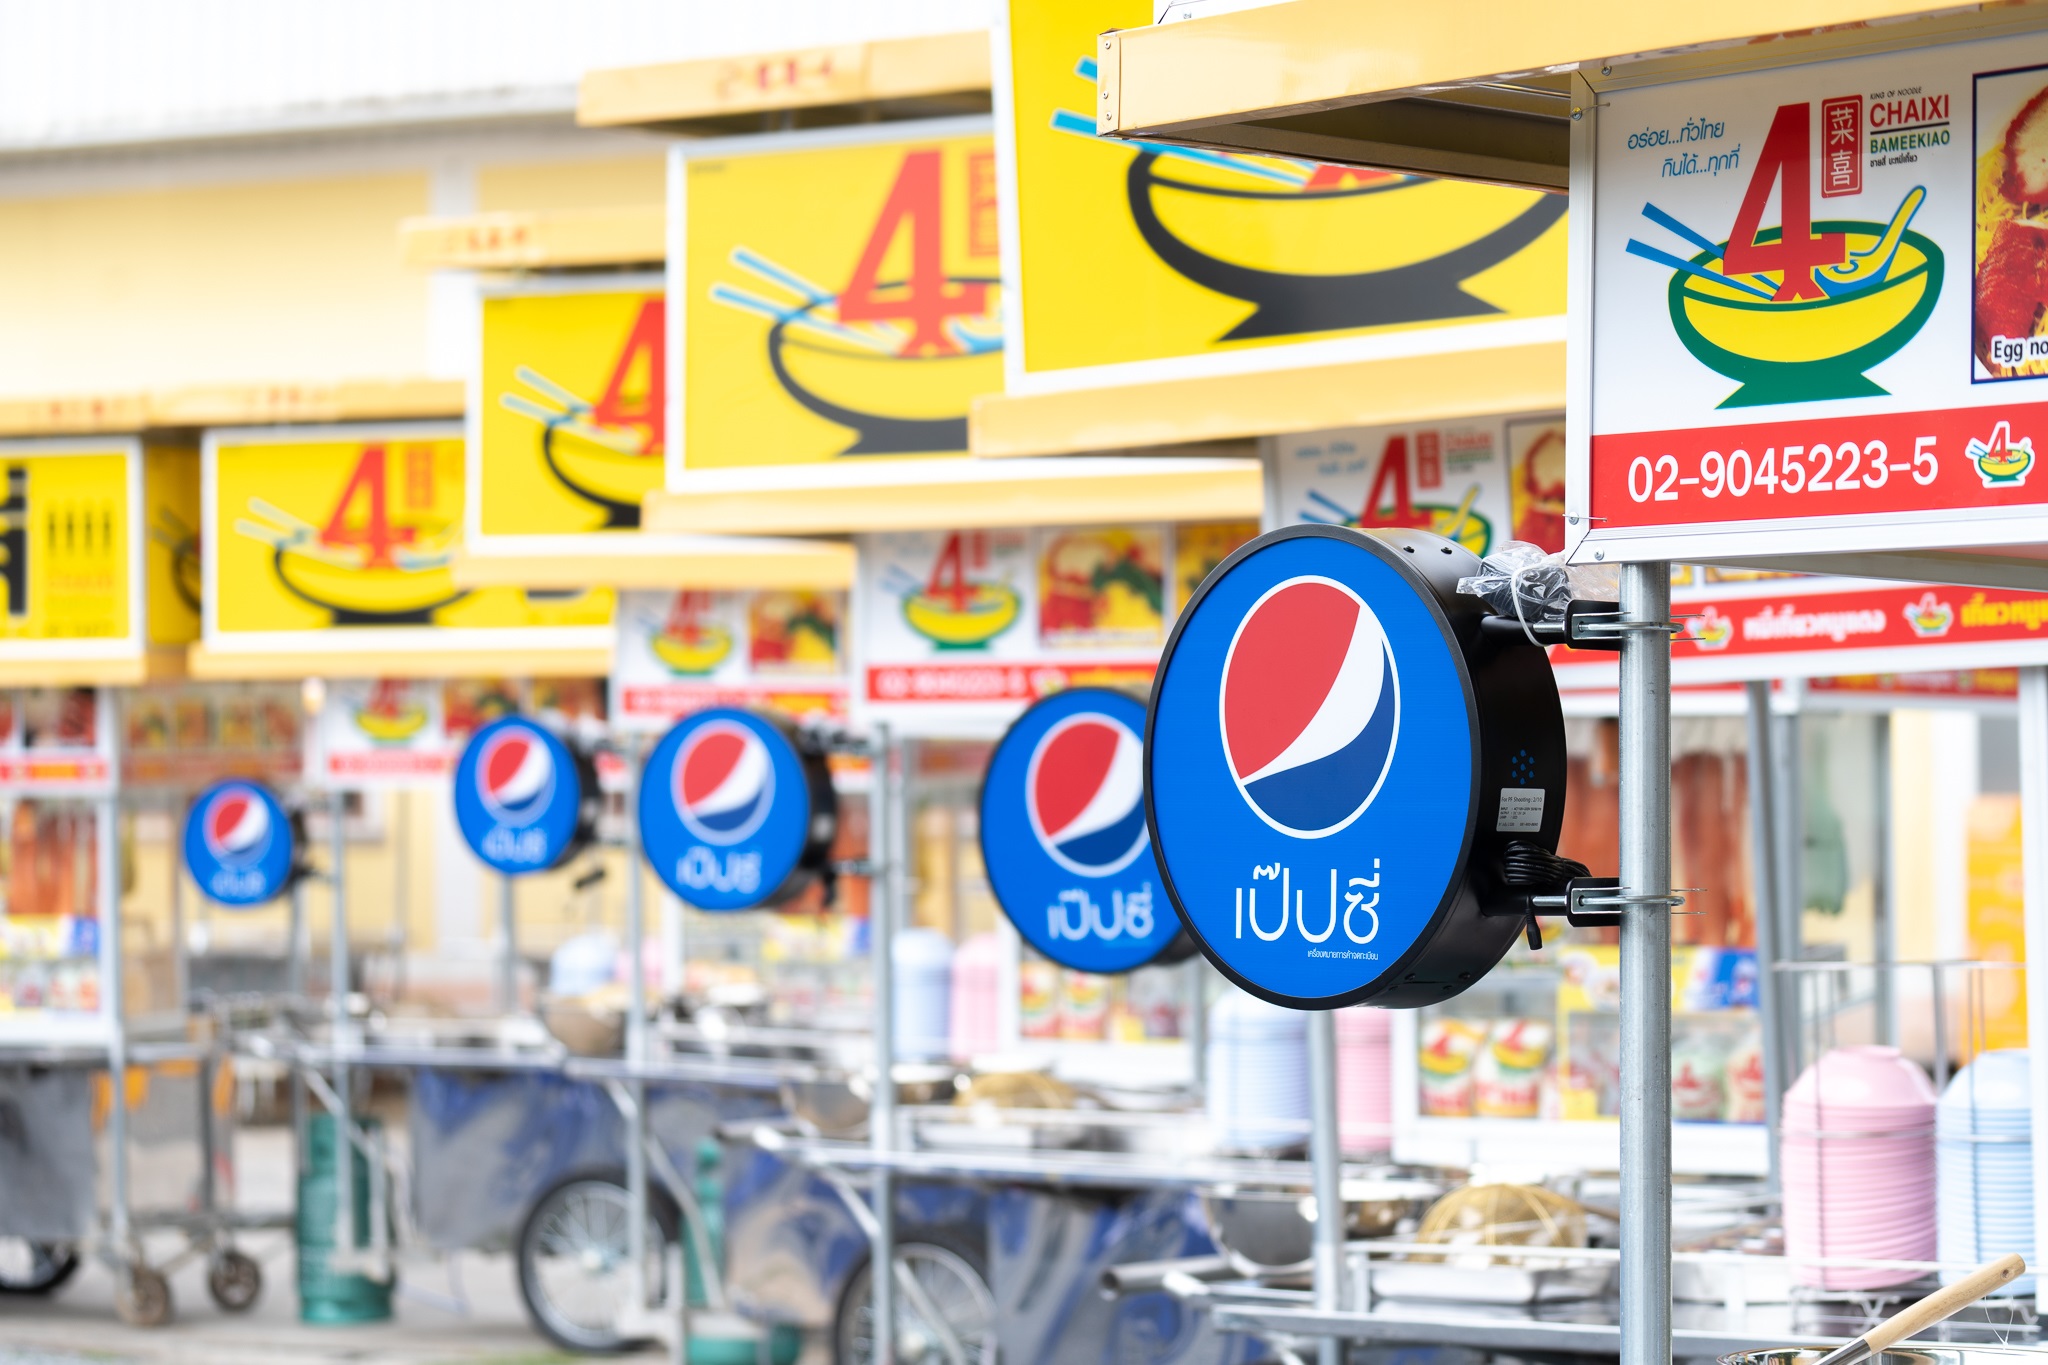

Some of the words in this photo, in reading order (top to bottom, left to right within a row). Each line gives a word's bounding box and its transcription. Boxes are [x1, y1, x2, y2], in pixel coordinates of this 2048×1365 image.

[1870, 91, 1885, 100] KING
[1887, 90, 1895, 98] OF
[1897, 86, 1922, 96] NOODLE
[1870, 94, 1949, 128] CHAIXI
[1628, 117, 1725, 149] อร่อย...ทั่วไทย
[1830, 106, 1855, 187] 菜喜
[1870, 129, 1950, 154] BAMEEKIAO
[1662, 143, 1741, 178] กินได้...ทุกที่
[1723, 102, 1845, 302] 4
[1994, 341, 2023, 363] Egg
[1628, 435, 1939, 503] 02-9045223-5
[1236, 858, 1380, 944] เป๊ปซี่
